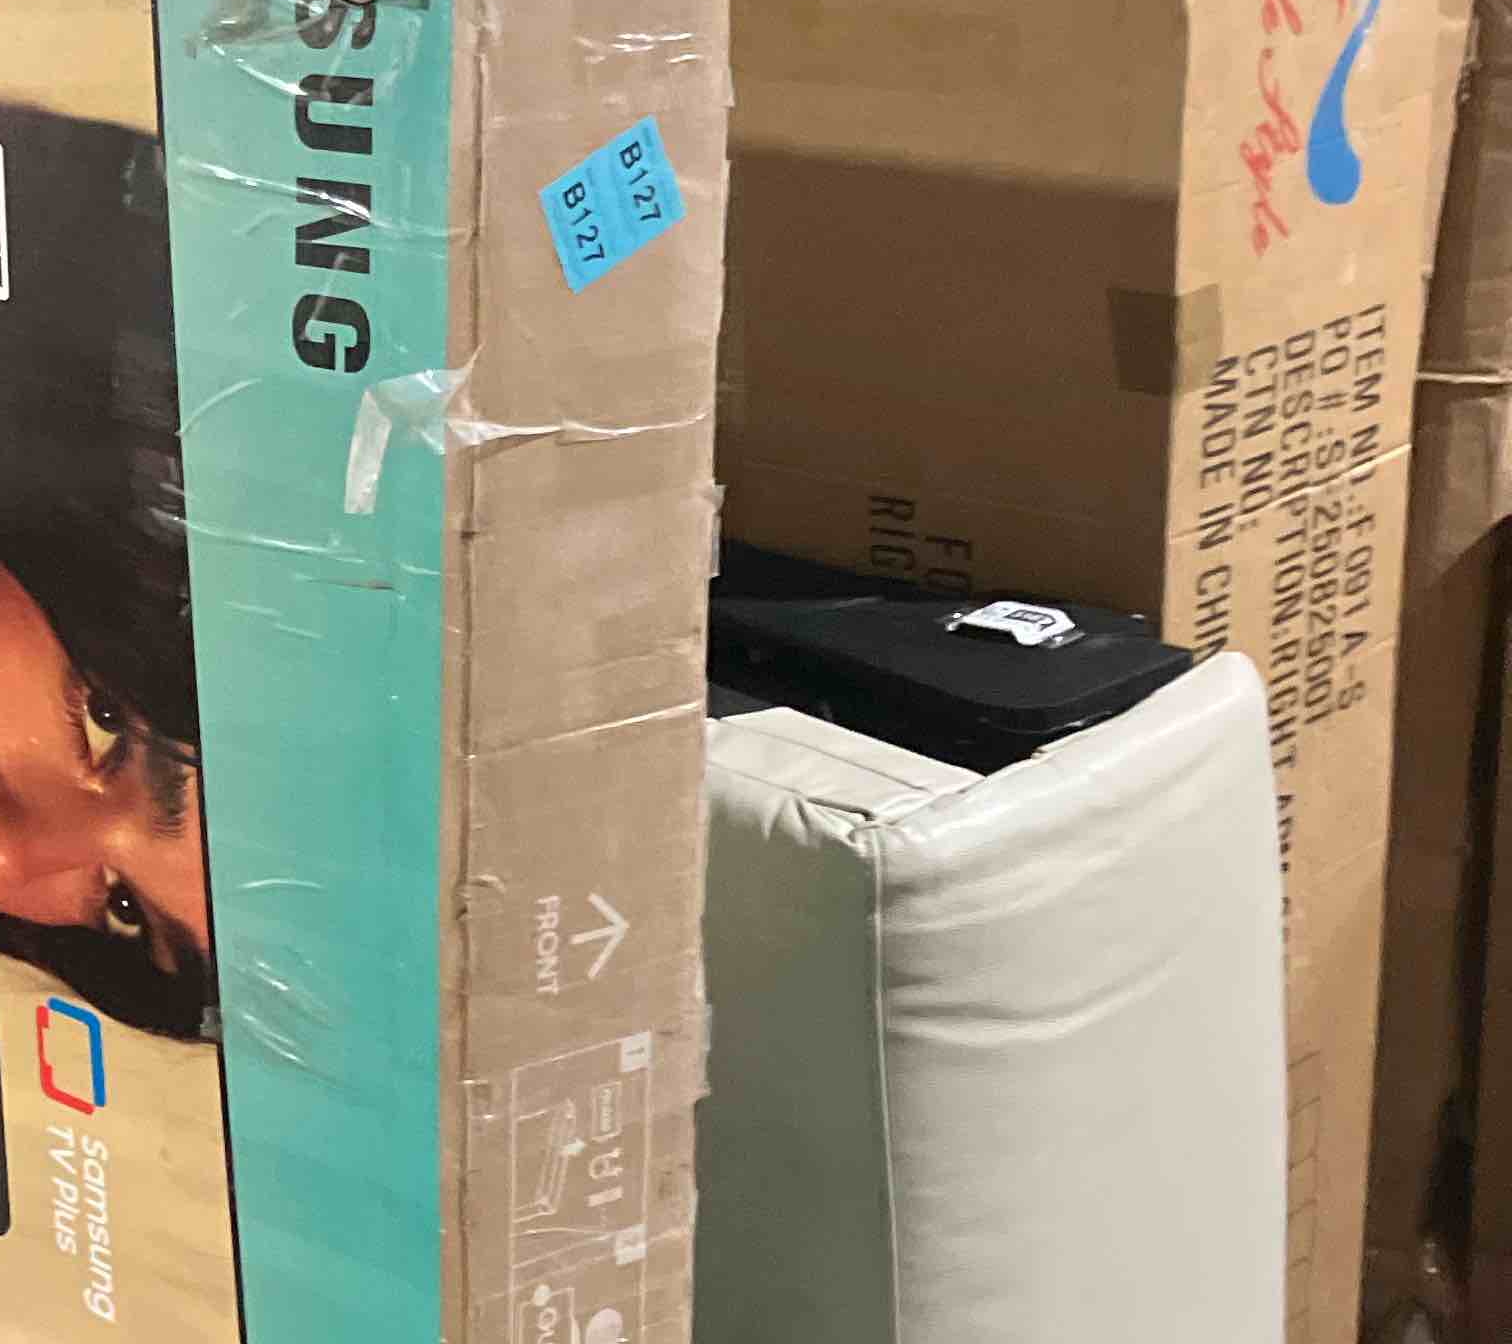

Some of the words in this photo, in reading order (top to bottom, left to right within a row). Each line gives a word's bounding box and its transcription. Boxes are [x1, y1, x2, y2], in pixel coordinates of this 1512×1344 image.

[563, 181, 605, 263] B127
[619, 141, 662, 222] B127
[1318, 315, 1352, 375] PO
[1350, 303, 1387, 411] ITEM
[1200, 355, 1239, 490] MADE
[1243, 344, 1279, 439] CTN
[868, 495, 917, 572] RIG
[1196, 503, 1233, 552] IN
[1192, 564, 1232, 662] CHIN
[535, 895, 561, 995] FRONT
[46, 1123, 75, 1172] TV
[51, 1176, 80, 1254] Plus
[79, 1134, 120, 1323] Samsung
